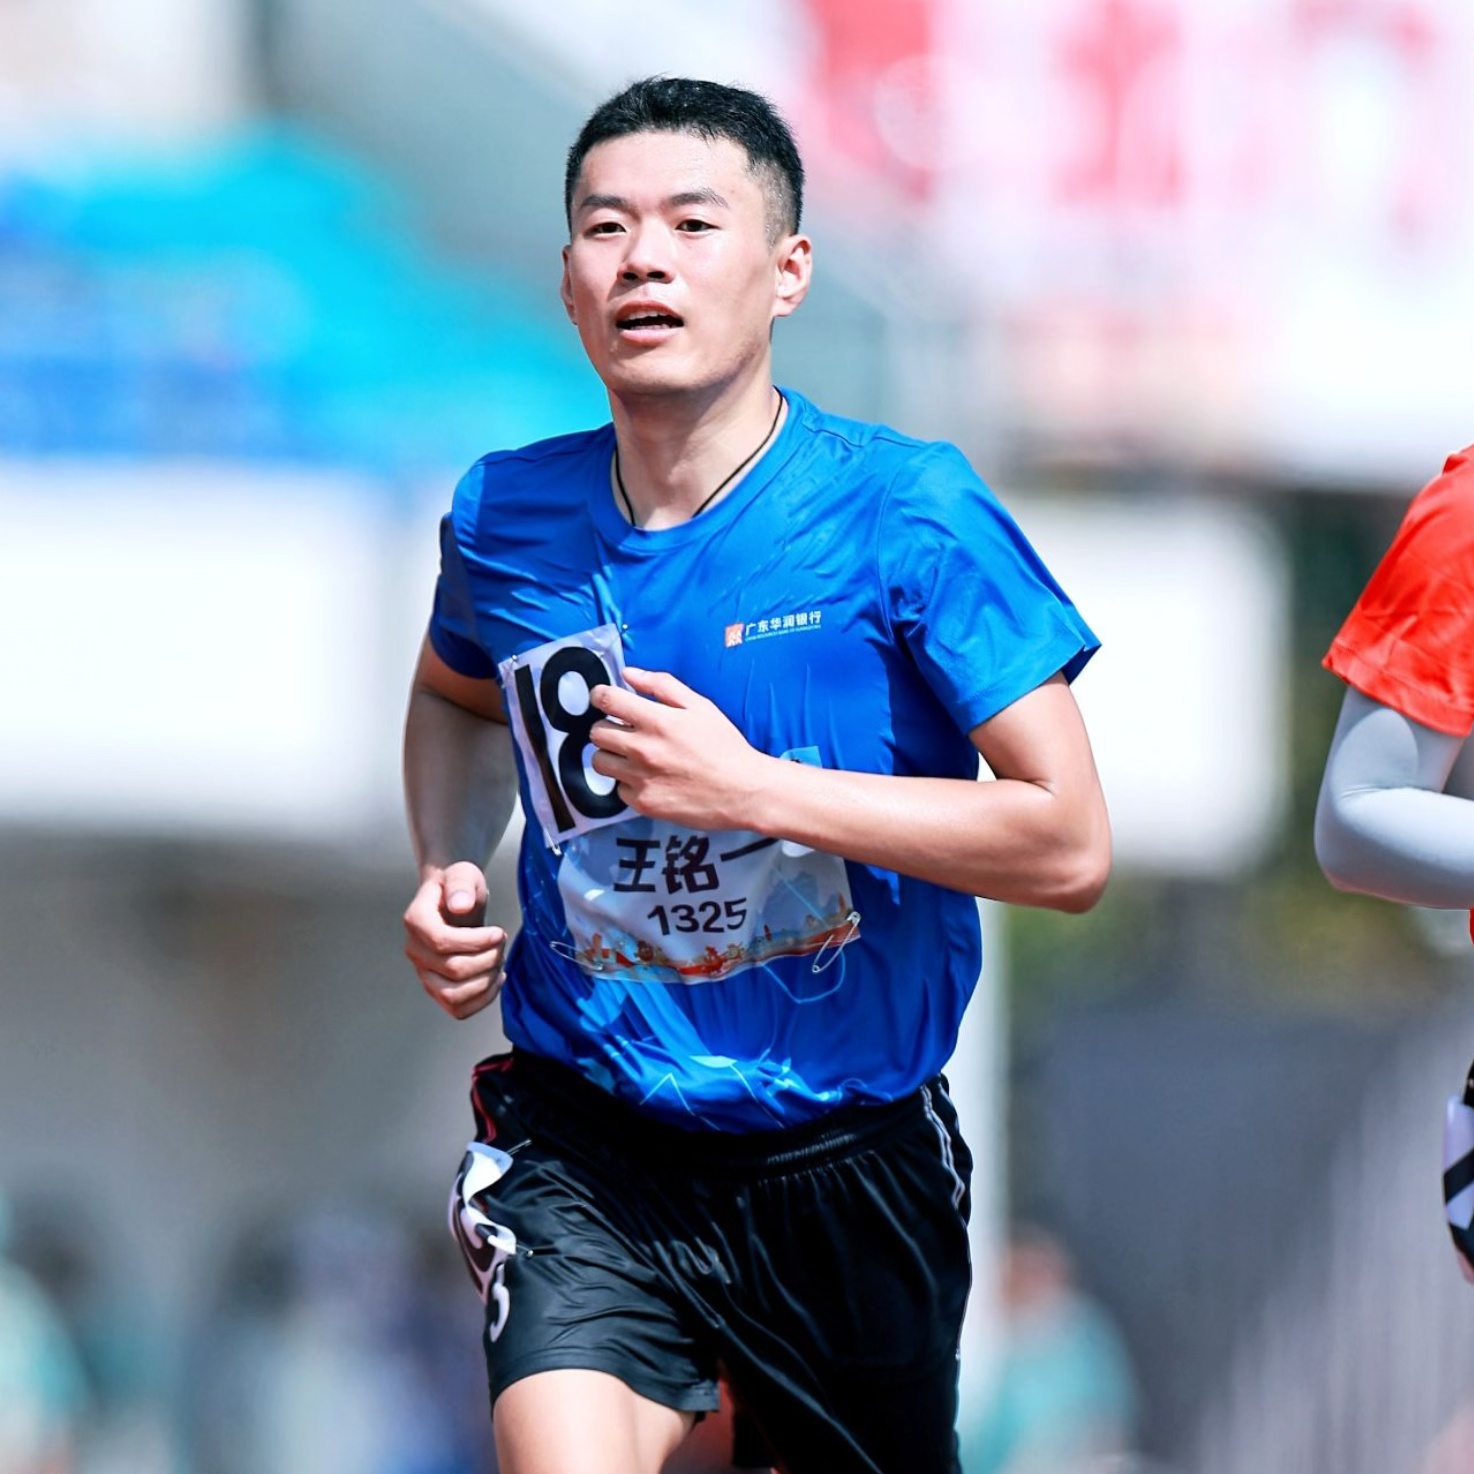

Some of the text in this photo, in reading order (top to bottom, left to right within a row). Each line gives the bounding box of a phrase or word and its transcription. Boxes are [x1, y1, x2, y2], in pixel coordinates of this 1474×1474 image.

[514, 646, 629, 833] 18
[613, 835, 781, 894] 王铭一
[647, 897, 747, 936] 1325
